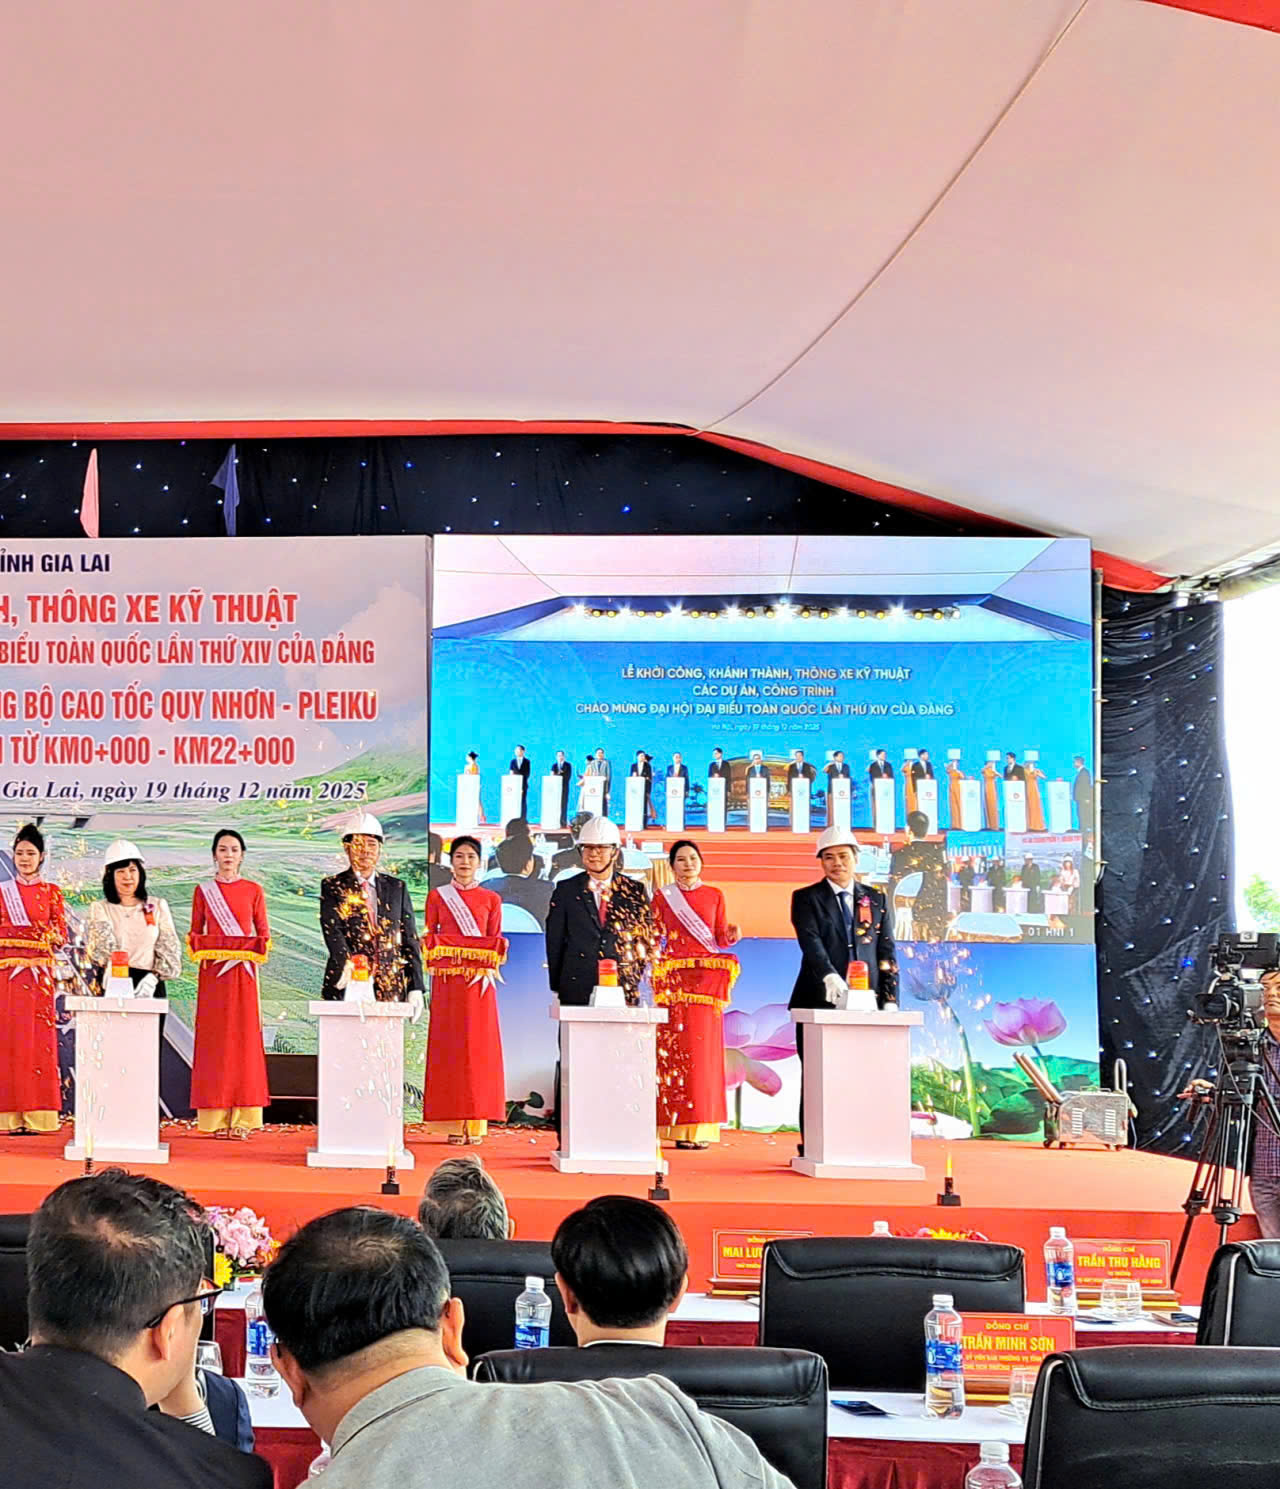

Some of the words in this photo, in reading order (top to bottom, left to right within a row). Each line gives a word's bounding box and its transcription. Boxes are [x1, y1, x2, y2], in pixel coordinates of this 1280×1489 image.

[41, 554, 74, 573] GIA
[80, 554, 110, 573] LAI
[26, 588, 117, 624] THÔNG
[126, 594, 160, 624] XE
[169, 589, 204, 624] KỸ
[211, 587, 299, 630] THUẬT
[46, 634, 95, 666] TOÀN
[101, 631, 151, 667] QUỐC
[157, 631, 194, 666] LẦN
[199, 634, 238, 666] THỨ
[241, 640, 272, 664] XIV
[277, 632, 317, 665] CỦA
[321, 633, 375, 664] ĐẢNG
[635, 665, 665, 679] KHỞI
[665, 665, 706, 680] CÔNG,
[708, 665, 748, 679] KHÁNH
[750, 665, 793, 681] THÀNH,
[794, 665, 838, 680] THÔNG
[838, 668, 854, 680] XE
[854, 666, 871, 679] KỸ
[872, 666, 911, 682] THUẬT
[692, 683, 719, 697] CÁC
[720, 684, 738, 699] DỰ
[739, 683, 760, 697] ÁN,
[762, 683, 799, 697] CÔNG
[800, 684, 835, 697] TRÌNH
[24, 685, 54, 726] BỘ
[61, 690, 105, 720] CAO
[111, 681, 154, 720] TỐC
[161, 690, 205, 722] QUY
[211, 686, 276, 720] NHƠN
[298, 690, 377, 720] PLEIKU
[10, 733, 40, 765] TỪ
[43, 735, 151, 765] KM0+000
[173, 736, 295, 766] KM22+000
[2, 780, 40, 800] Gia
[45, 780, 85, 804] Lai,
[90, 783, 139, 805] ngày
[145, 781, 168, 800] 19
[172, 780, 231, 805] tháng
[238, 781, 261, 800] 12
[265, 779, 315, 800] năm
[317, 780, 367, 801] 2025
[1243, 931, 1253, 940] 3
[722, 1246, 744, 1257] MAI
[1108, 1255, 1129, 1268] THU
[995, 1335, 1027, 1351] MINH
[1029, 1334, 1056, 1352] SƠN
